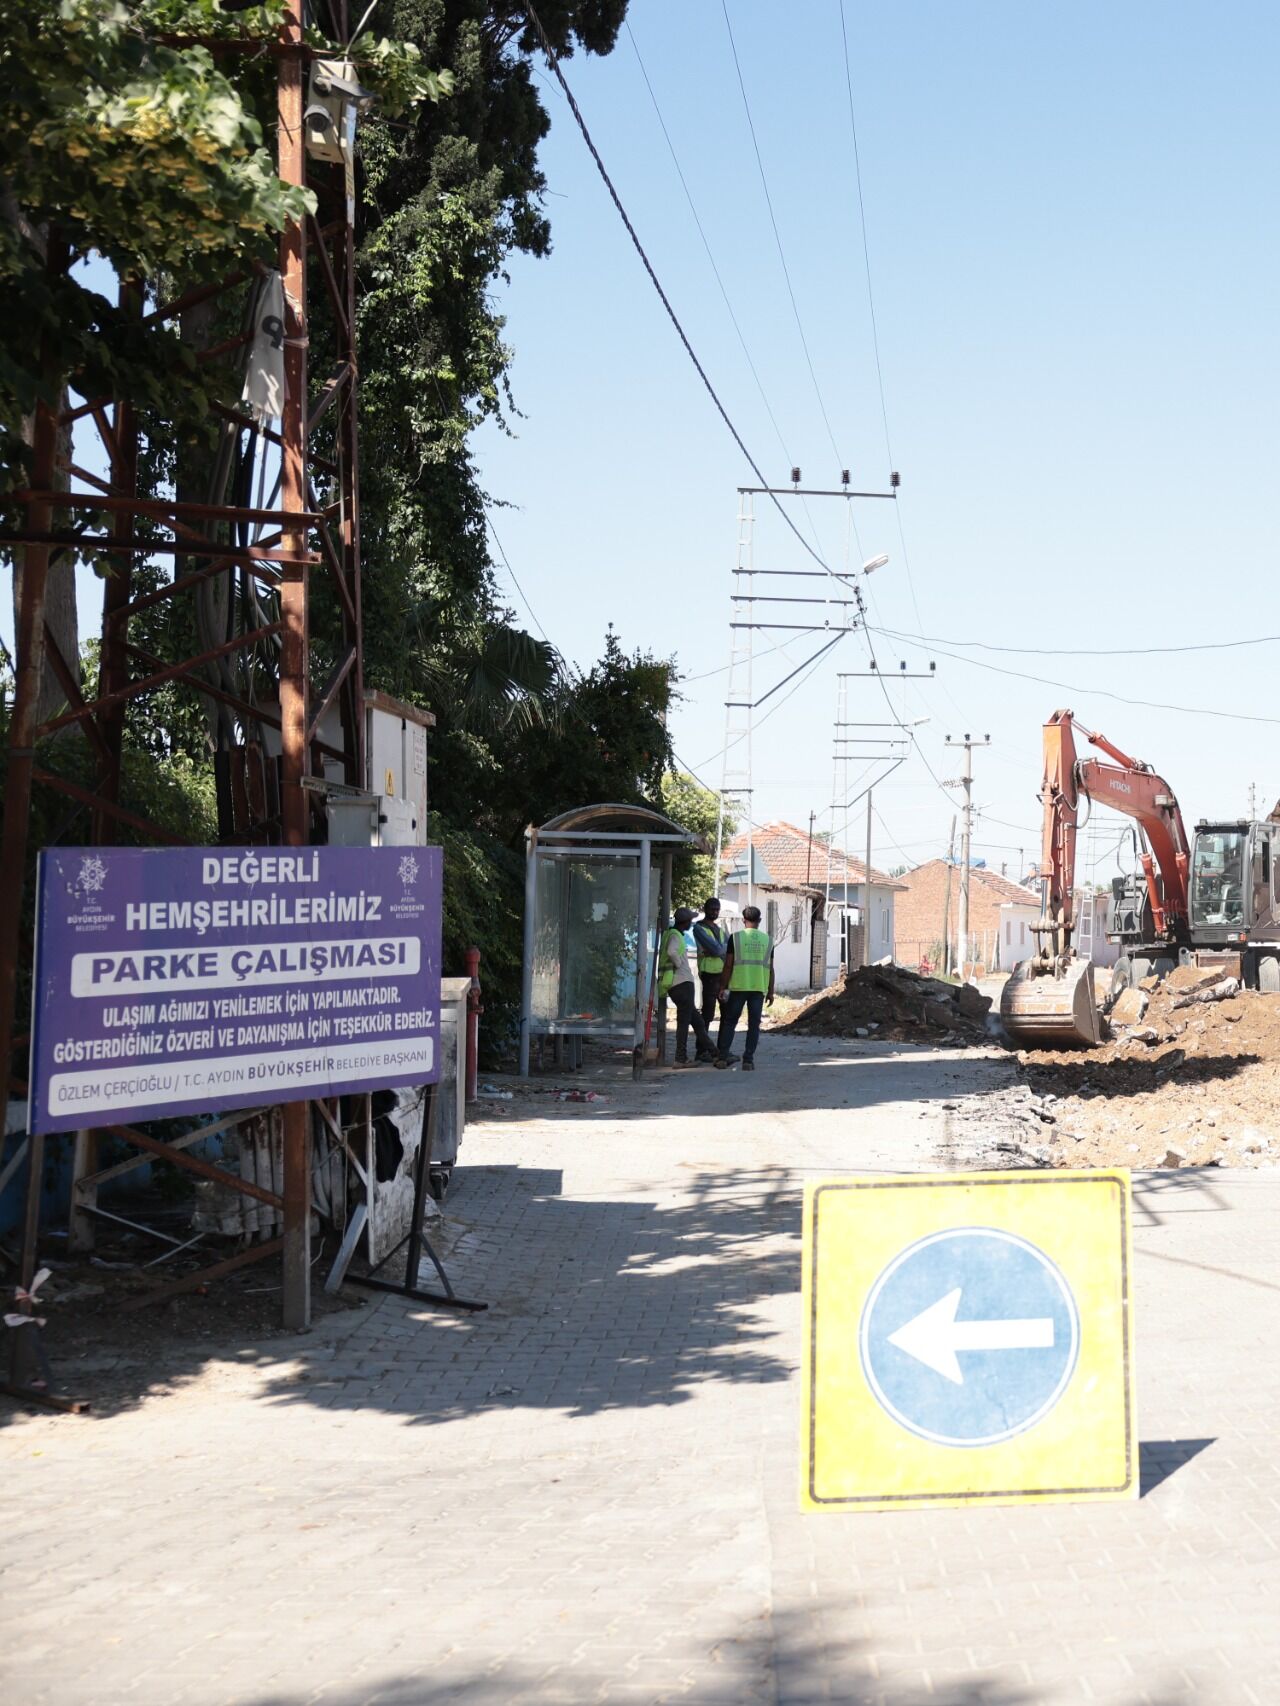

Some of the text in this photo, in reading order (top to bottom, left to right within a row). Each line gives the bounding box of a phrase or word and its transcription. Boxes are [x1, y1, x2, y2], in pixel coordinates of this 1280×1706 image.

[202, 850, 319, 885] DEĞERLİ
[126, 890, 382, 935] HEMŞEHRİLERİMİZ
[92, 942, 406, 984] PARKE ÇALIŞMASI
[103, 986, 401, 1030] ULAŞIM AĞIMIZI YENİLEMEK İÇİN YAPILMAKTADIR.
[53, 1007, 435, 1063] GÖSTERDİĞİNİZ ÖZVERİ VE DAYANIŞMA İÇİN TEŞEKKÜR EDERİZ.
[58, 1084, 100, 1101] ÖZLEM
[103, 1075, 172, 1099] ÇERÇİOĞLU
[184, 1074, 204, 1087] T.C.
[207, 1068, 244, 1085] AYDIN
[248, 1057, 335, 1080] BÜYÜKŞEHİR
[336, 1054, 381, 1071] BELEDİYE
[383, 1050, 427, 1068] BAŞKANI
